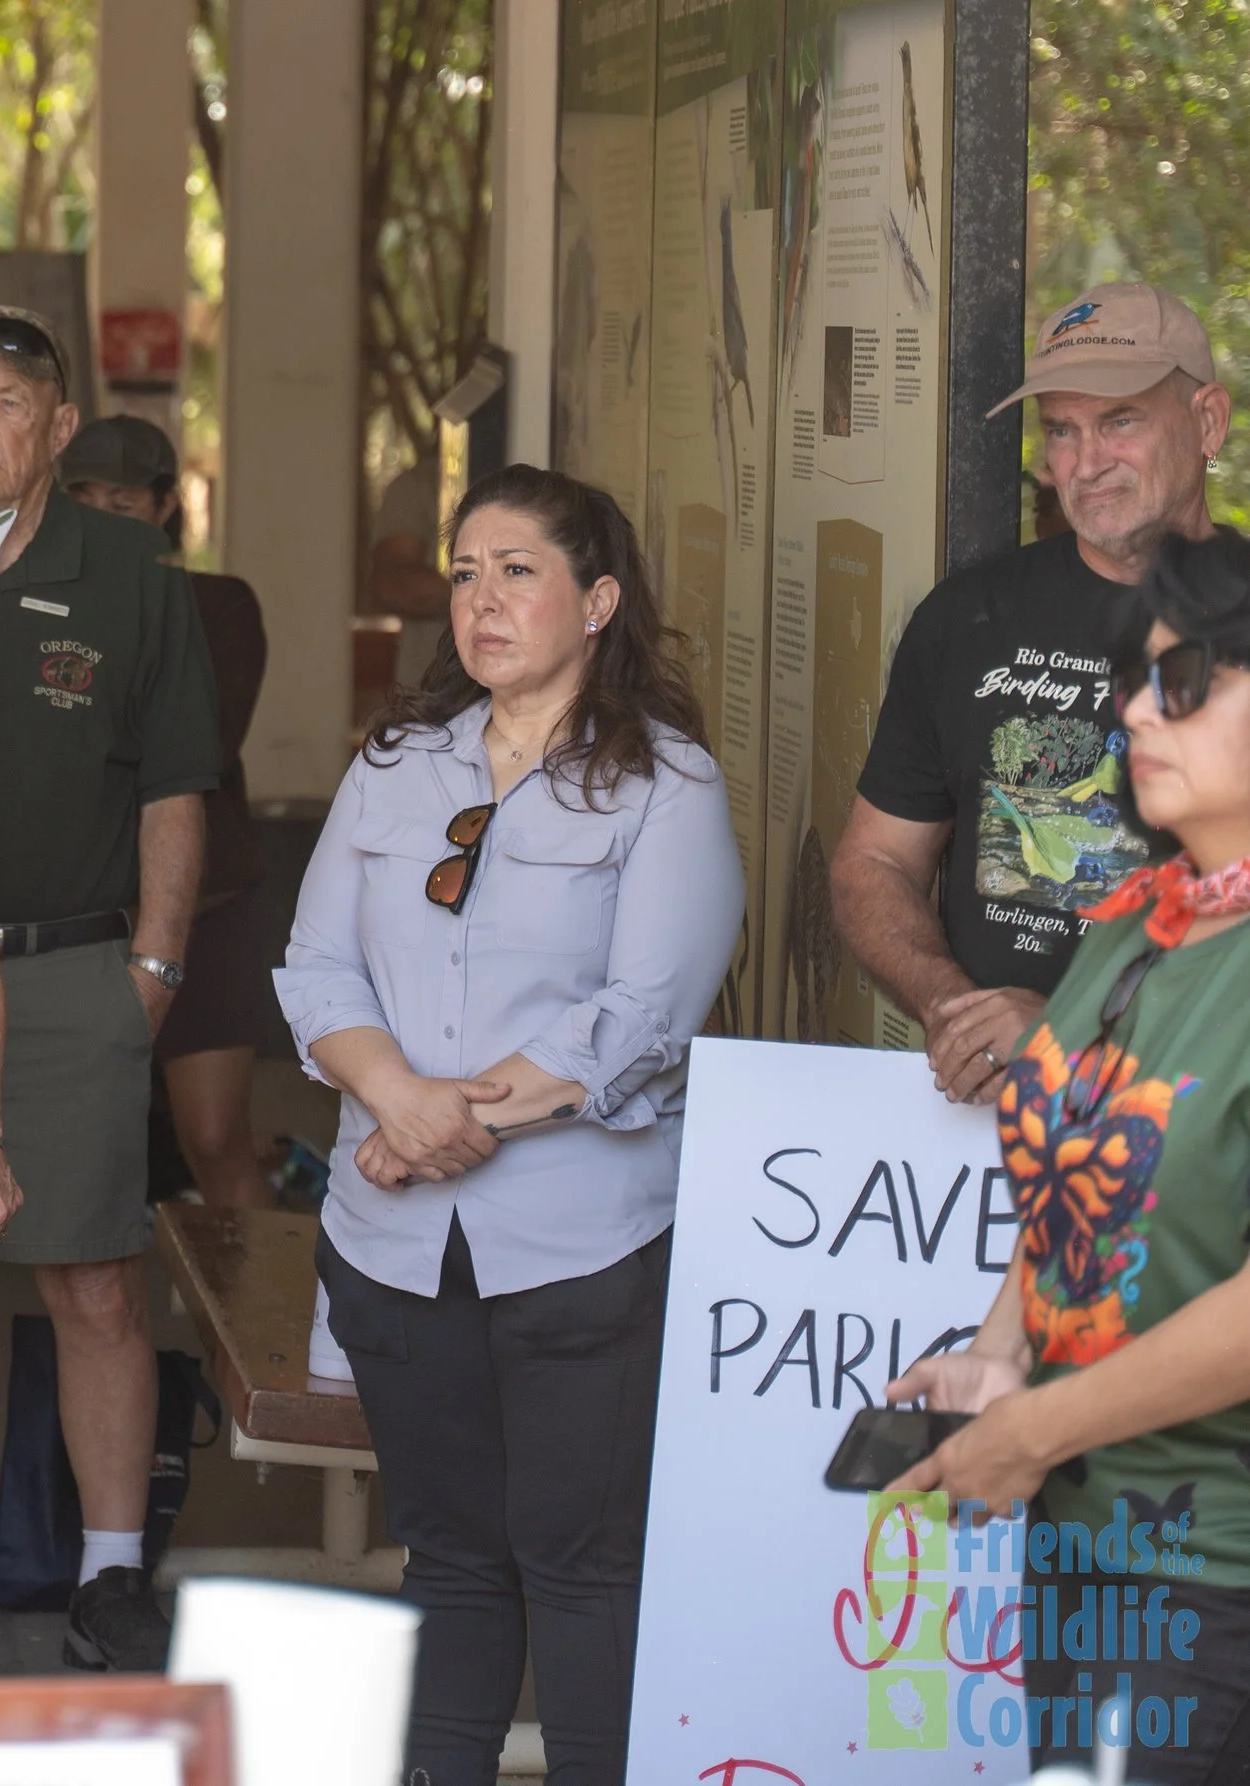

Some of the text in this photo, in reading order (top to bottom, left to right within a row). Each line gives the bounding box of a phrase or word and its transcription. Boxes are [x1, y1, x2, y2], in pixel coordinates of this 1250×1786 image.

[40, 640, 102, 664] OREGON
[1014, 648, 1045, 666] Rio
[33, 686, 93, 706] SPORTSMAN'S
[51, 697, 74, 709] CLUB
[975, 667, 1082, 711] Birding
[985, 903, 1070, 937] Harlingen,
[752, 1147, 1018, 1273] SAVE
[709, 1298, 981, 1410] PARK
